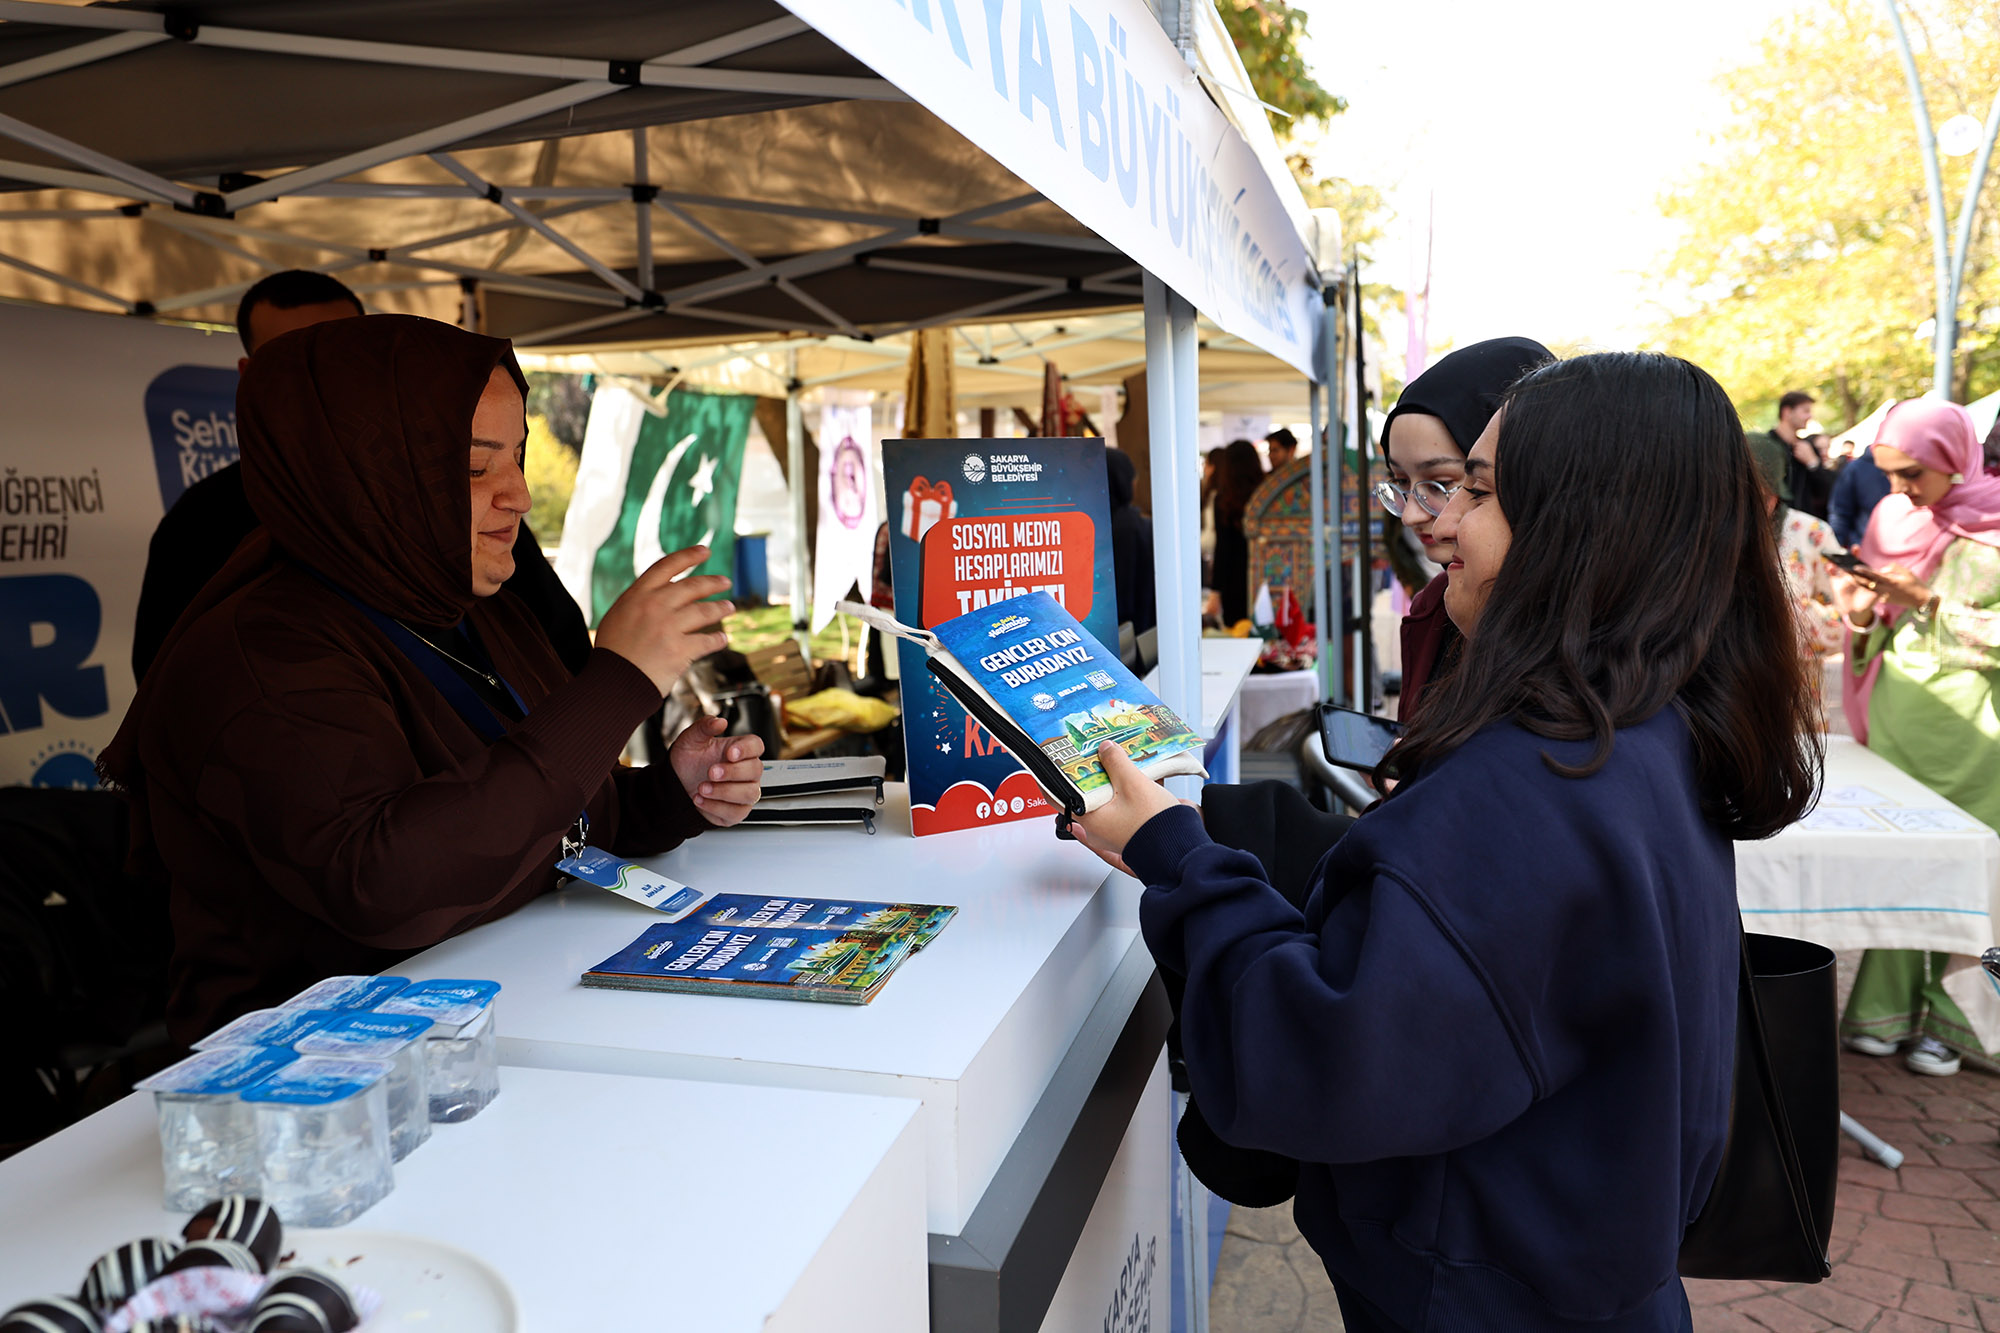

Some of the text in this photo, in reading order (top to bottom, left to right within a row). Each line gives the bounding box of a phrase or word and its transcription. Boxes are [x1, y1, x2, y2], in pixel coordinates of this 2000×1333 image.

[990, 454, 1029, 464] SAKARYA
[991, 462, 1043, 475] BÜYÜKŞEHİR
[992, 472, 1038, 482] BELEDİYESİ
[952, 520, 1061, 550] SOSYAL MEDYA
[954, 550, 1063, 581] HESAPLARIMIZI
[980, 637, 1052, 672] GENÇLER
[1000, 646, 1094, 689] BURADAYIZ
